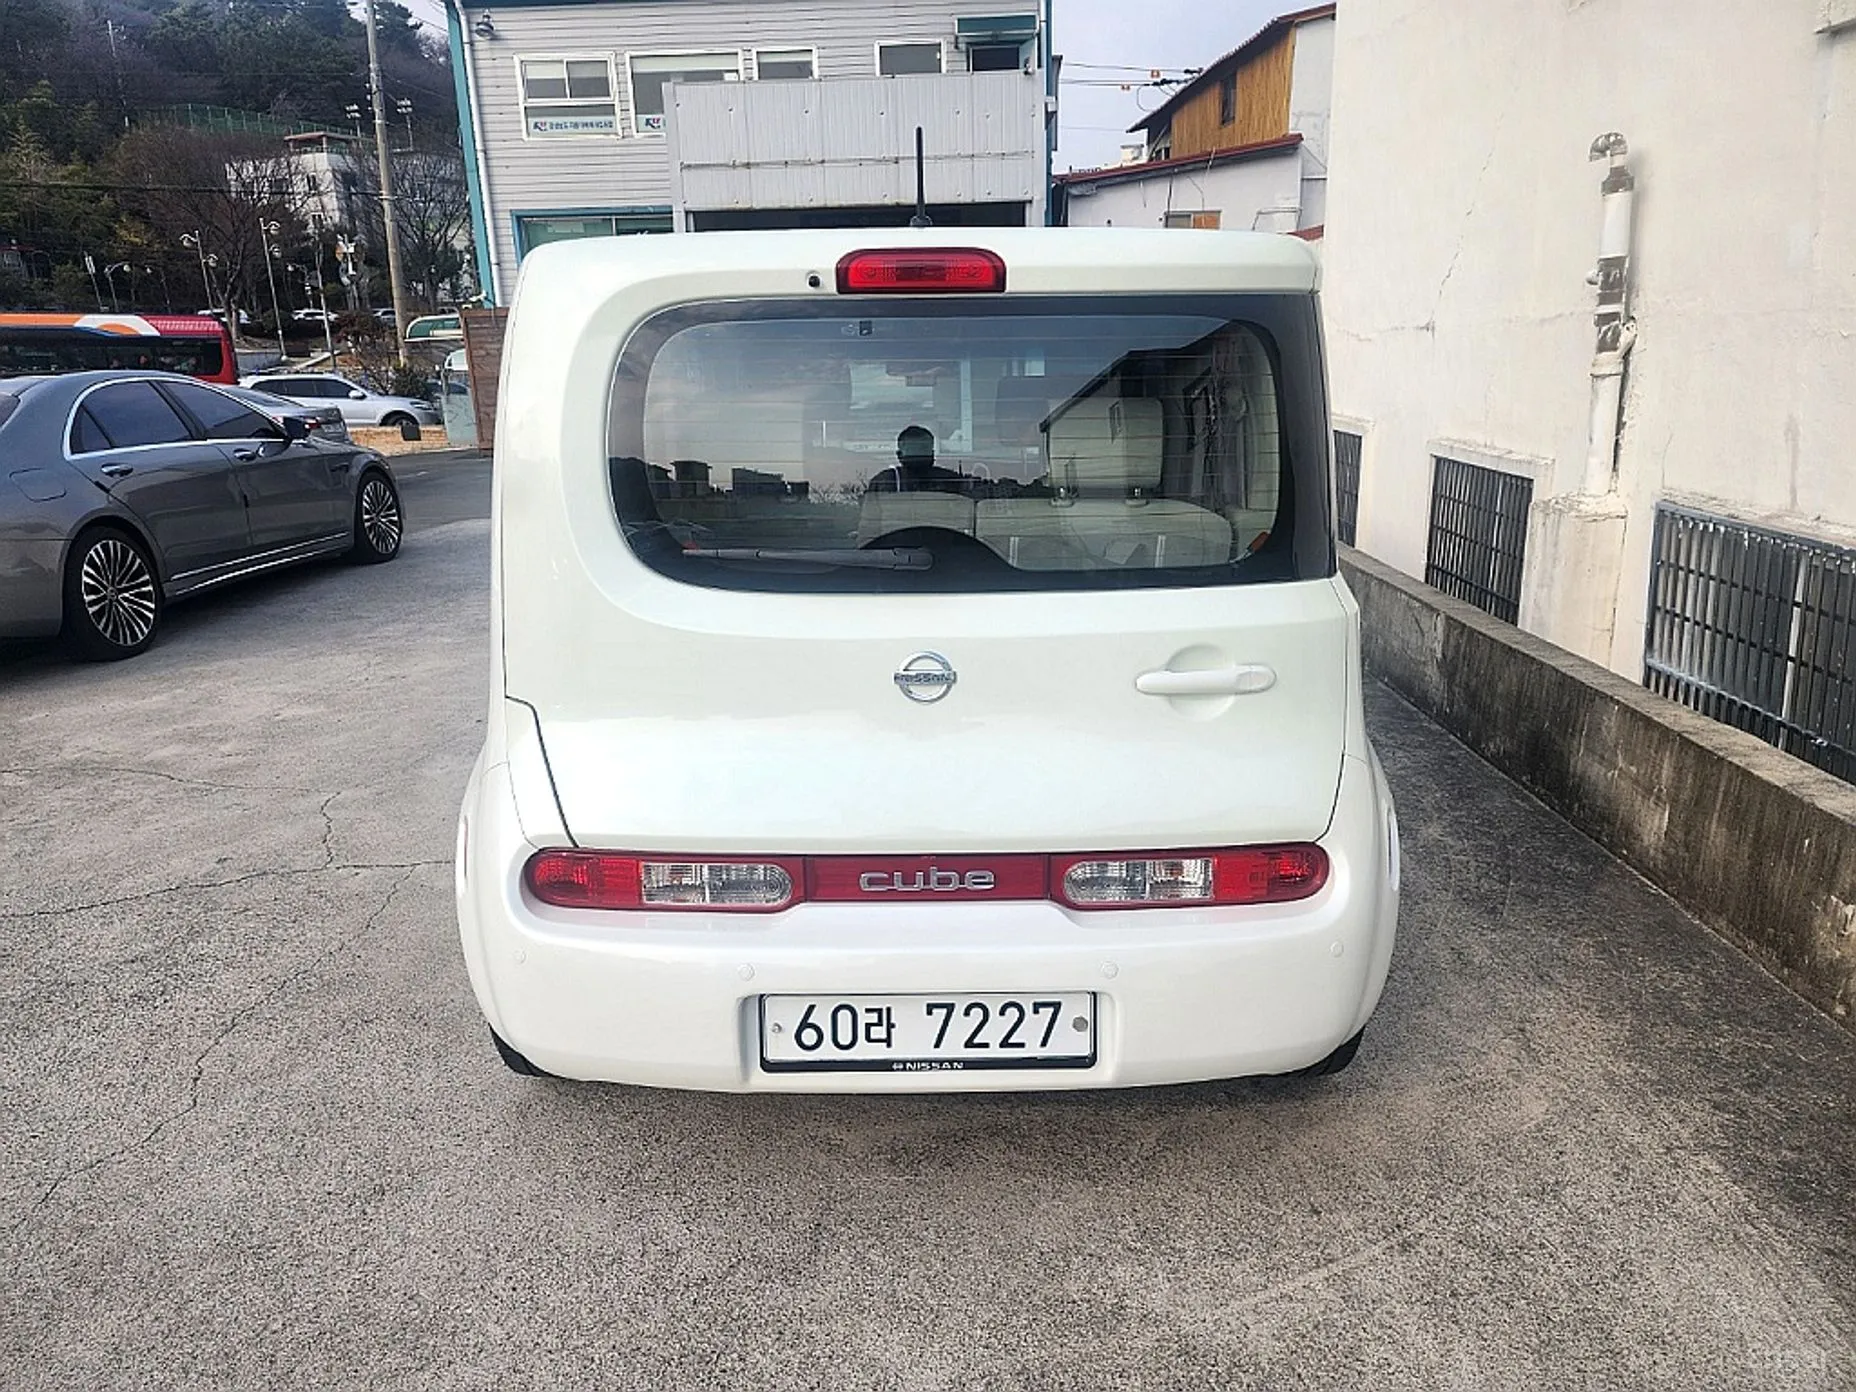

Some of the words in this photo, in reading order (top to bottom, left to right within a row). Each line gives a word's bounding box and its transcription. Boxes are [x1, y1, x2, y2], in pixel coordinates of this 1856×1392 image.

[859, 866, 995, 892] cube
[794, 1003, 896, 1051] 60라
[926, 1001, 1062, 1049] 7227
[905, 1061, 964, 1071] NISSAN
